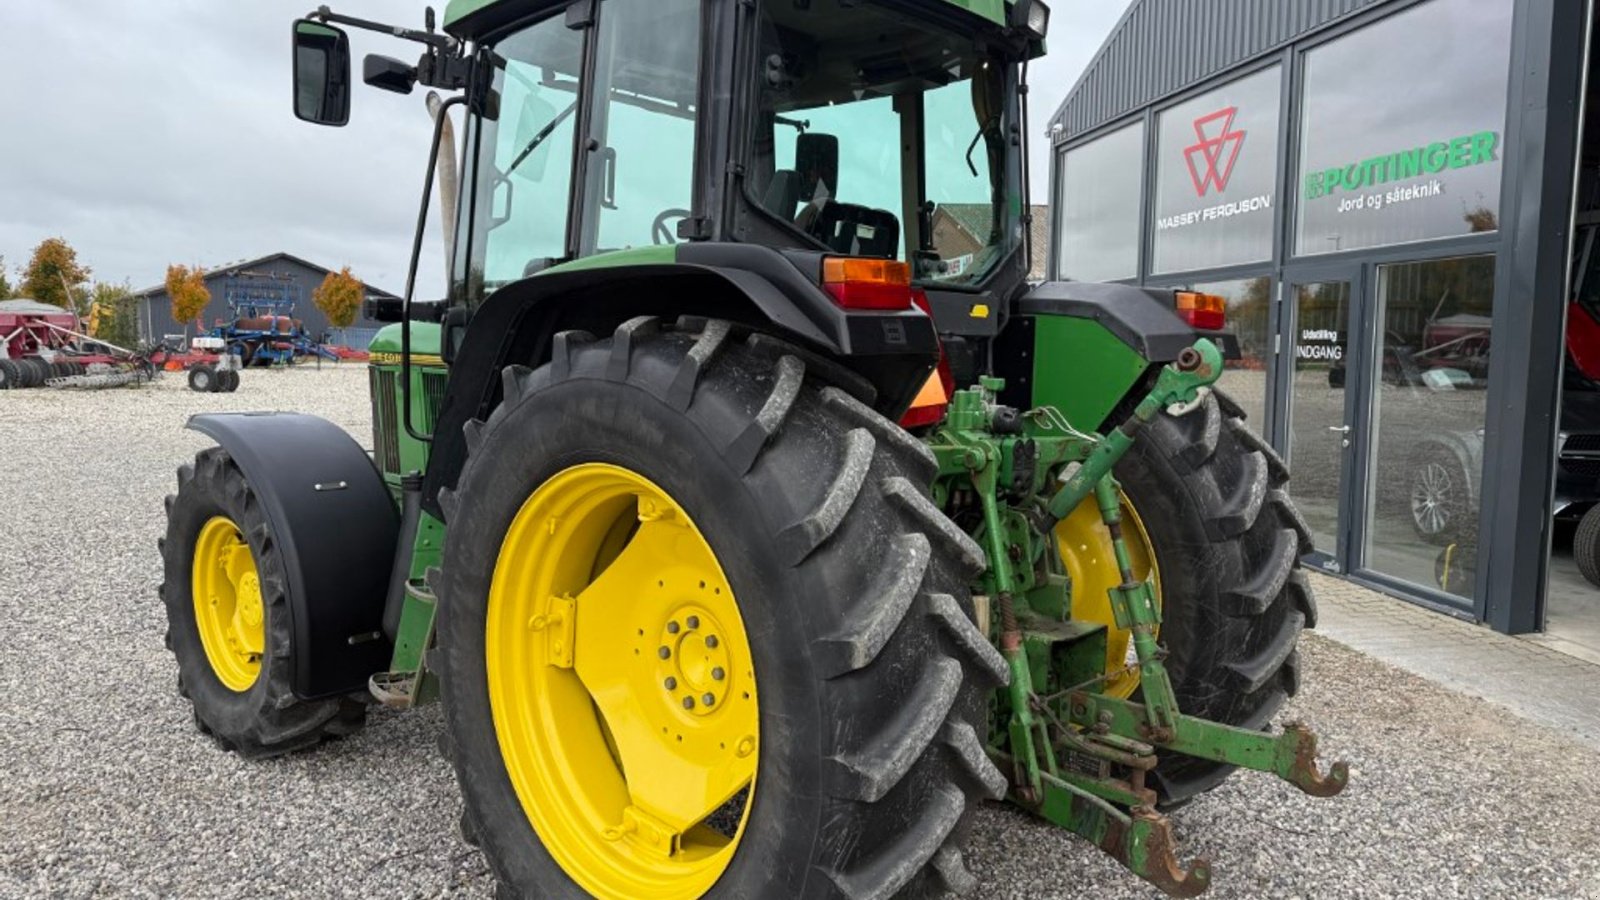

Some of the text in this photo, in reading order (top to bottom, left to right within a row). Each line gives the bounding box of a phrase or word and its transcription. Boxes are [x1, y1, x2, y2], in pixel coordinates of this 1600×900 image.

[1158, 195, 1271, 230] MASSEY FERGUSON
[1337, 179, 1442, 213] Jord og såteknik
[1296, 345, 1342, 360] INDGANG
